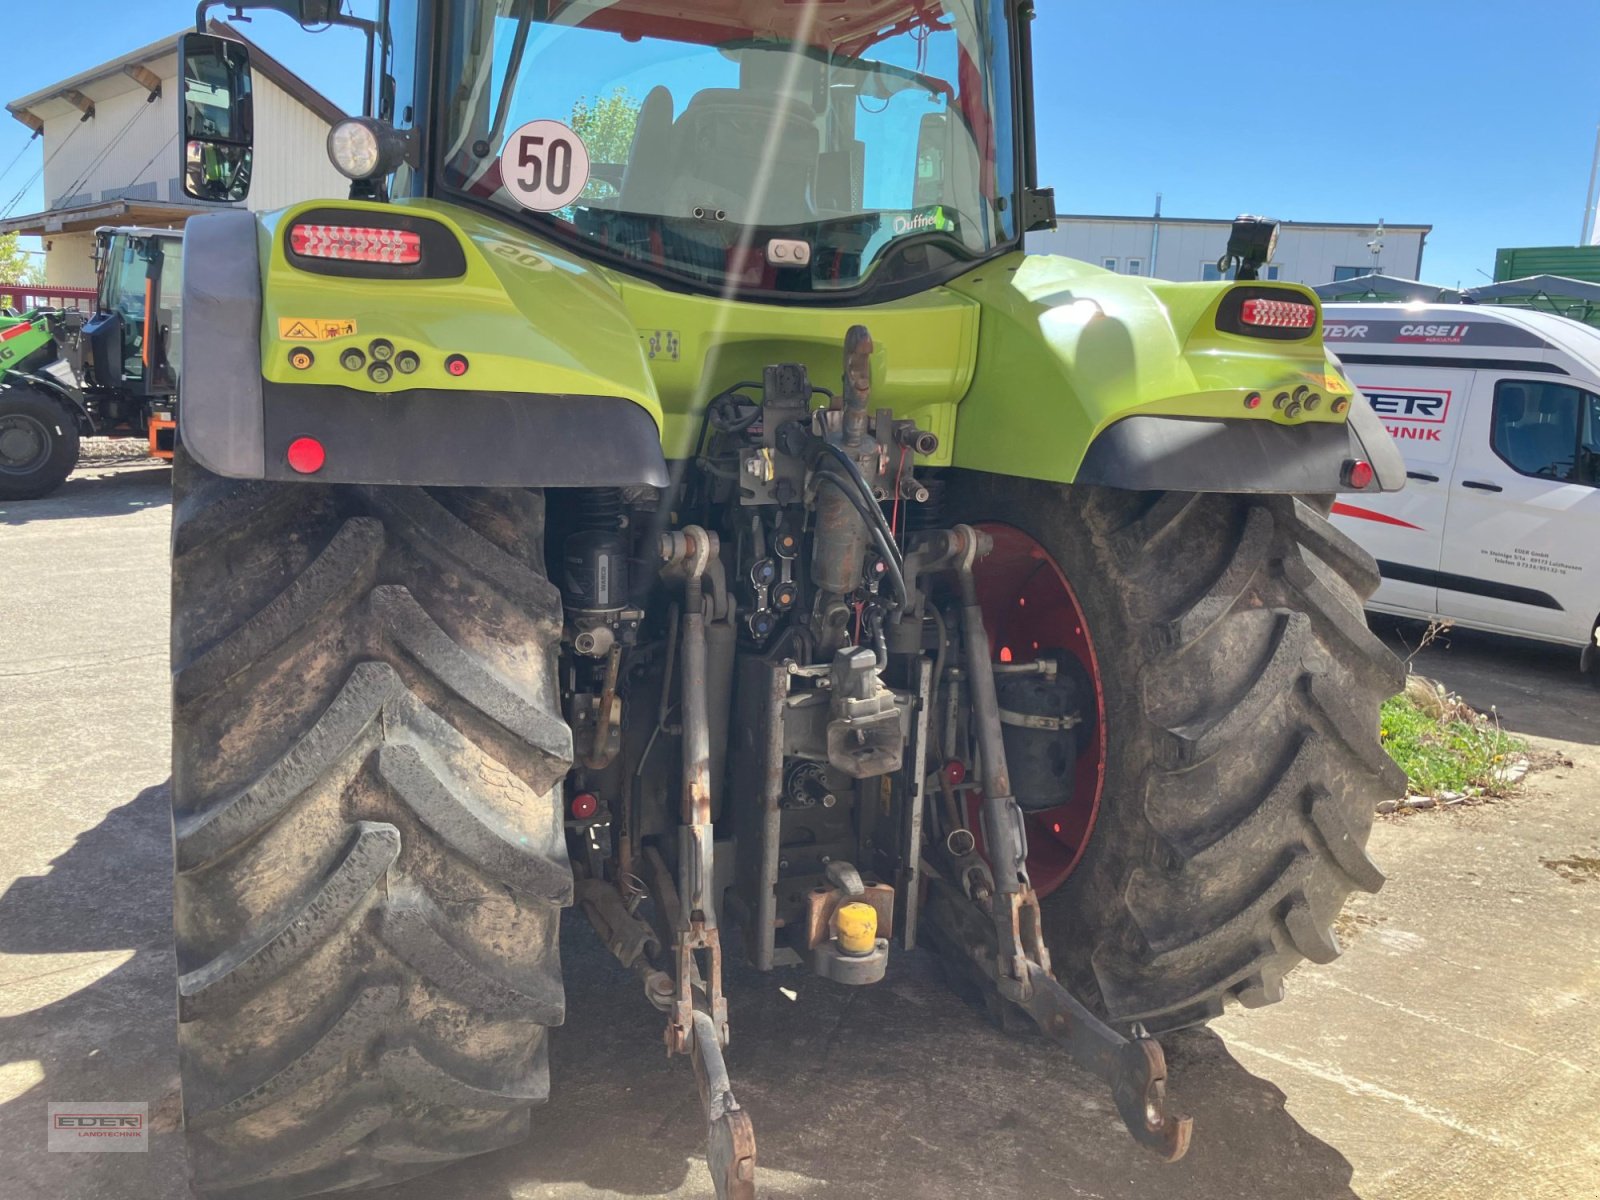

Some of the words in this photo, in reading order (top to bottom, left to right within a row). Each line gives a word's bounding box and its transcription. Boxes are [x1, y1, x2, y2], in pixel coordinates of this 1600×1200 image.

[517, 135, 572, 195] 50
[1322, 324, 1369, 338] TEYR
[1400, 325, 1450, 337] CASE
